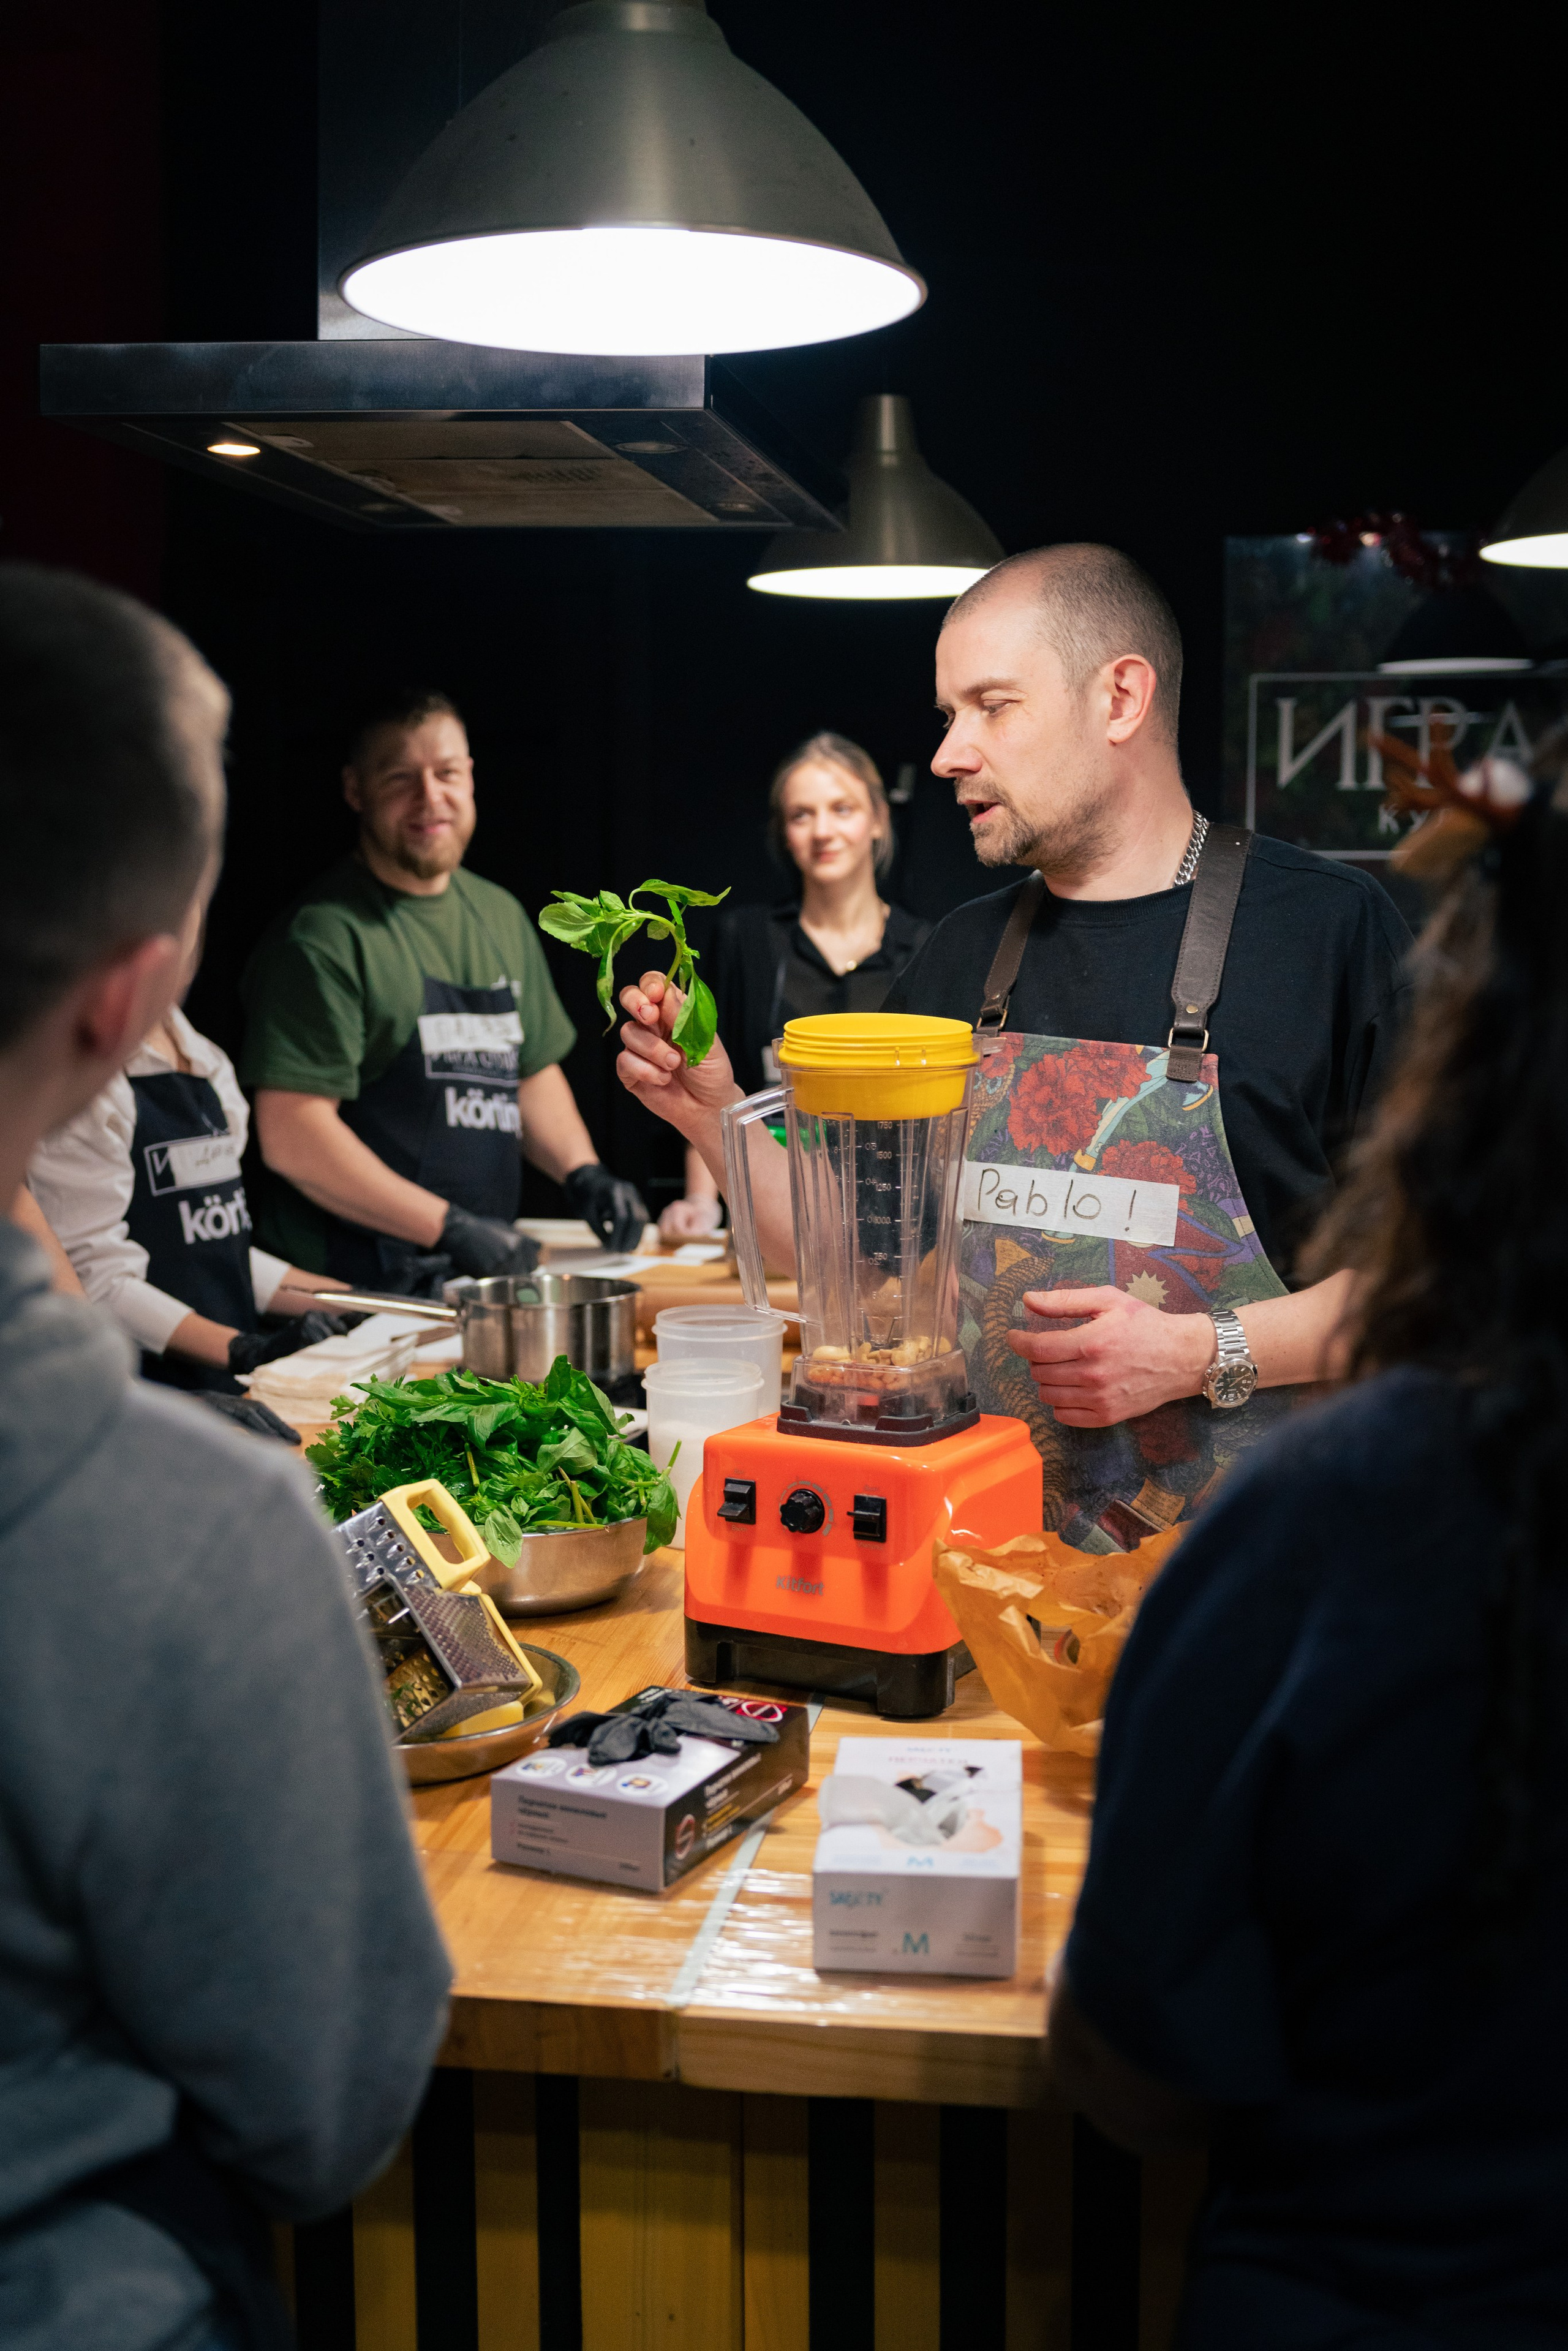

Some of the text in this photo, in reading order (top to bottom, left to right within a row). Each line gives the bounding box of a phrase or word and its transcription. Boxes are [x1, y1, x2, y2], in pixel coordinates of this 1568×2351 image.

[876, 1151, 892, 1160] 1500
[978, 1168, 1102, 1220] Pablo
[776, 1575, 824, 1596] Kitfort
[903, 1931, 930, 1955] M
